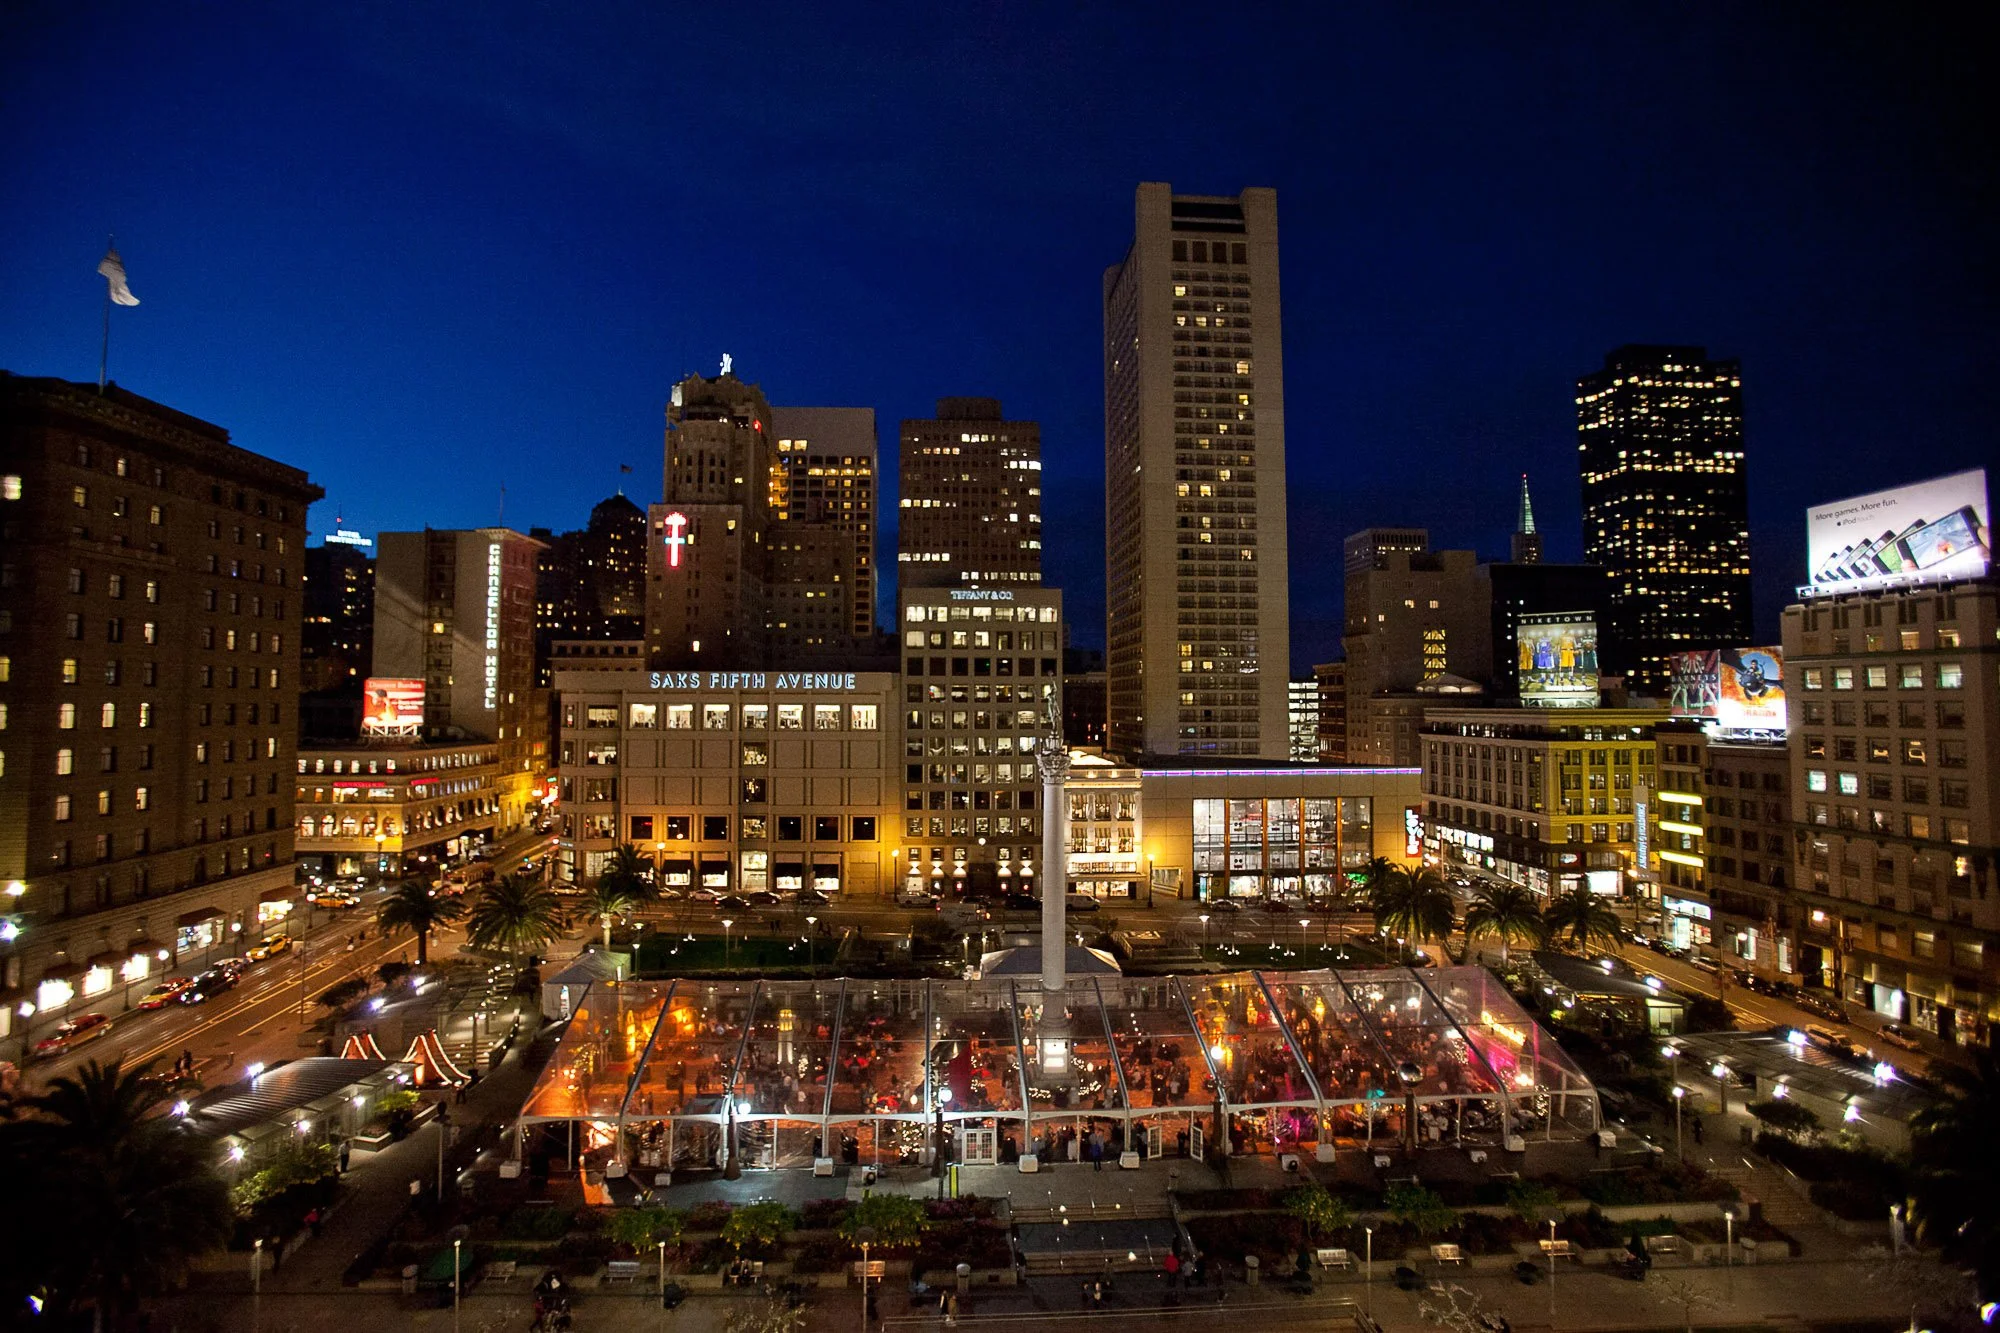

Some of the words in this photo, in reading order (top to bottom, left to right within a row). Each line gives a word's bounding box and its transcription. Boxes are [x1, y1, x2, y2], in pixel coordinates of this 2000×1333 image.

[1815, 513, 1833, 521] More
[1835, 507, 1860, 518] games.
[1861, 502, 1881, 511] More
[1882, 499, 1898, 507] fun.
[487, 544, 500, 649] CHANCELLOR
[950, 590, 990, 600] TIFFANY
[991, 591, 998, 600] &
[1521, 615, 1592, 624] NIKETOWN
[485, 655, 497, 709] HOTEL
[650, 672, 700, 689] SAKS
[710, 673, 765, 689] FIFTH
[776, 673, 856, 689] AVENUE
